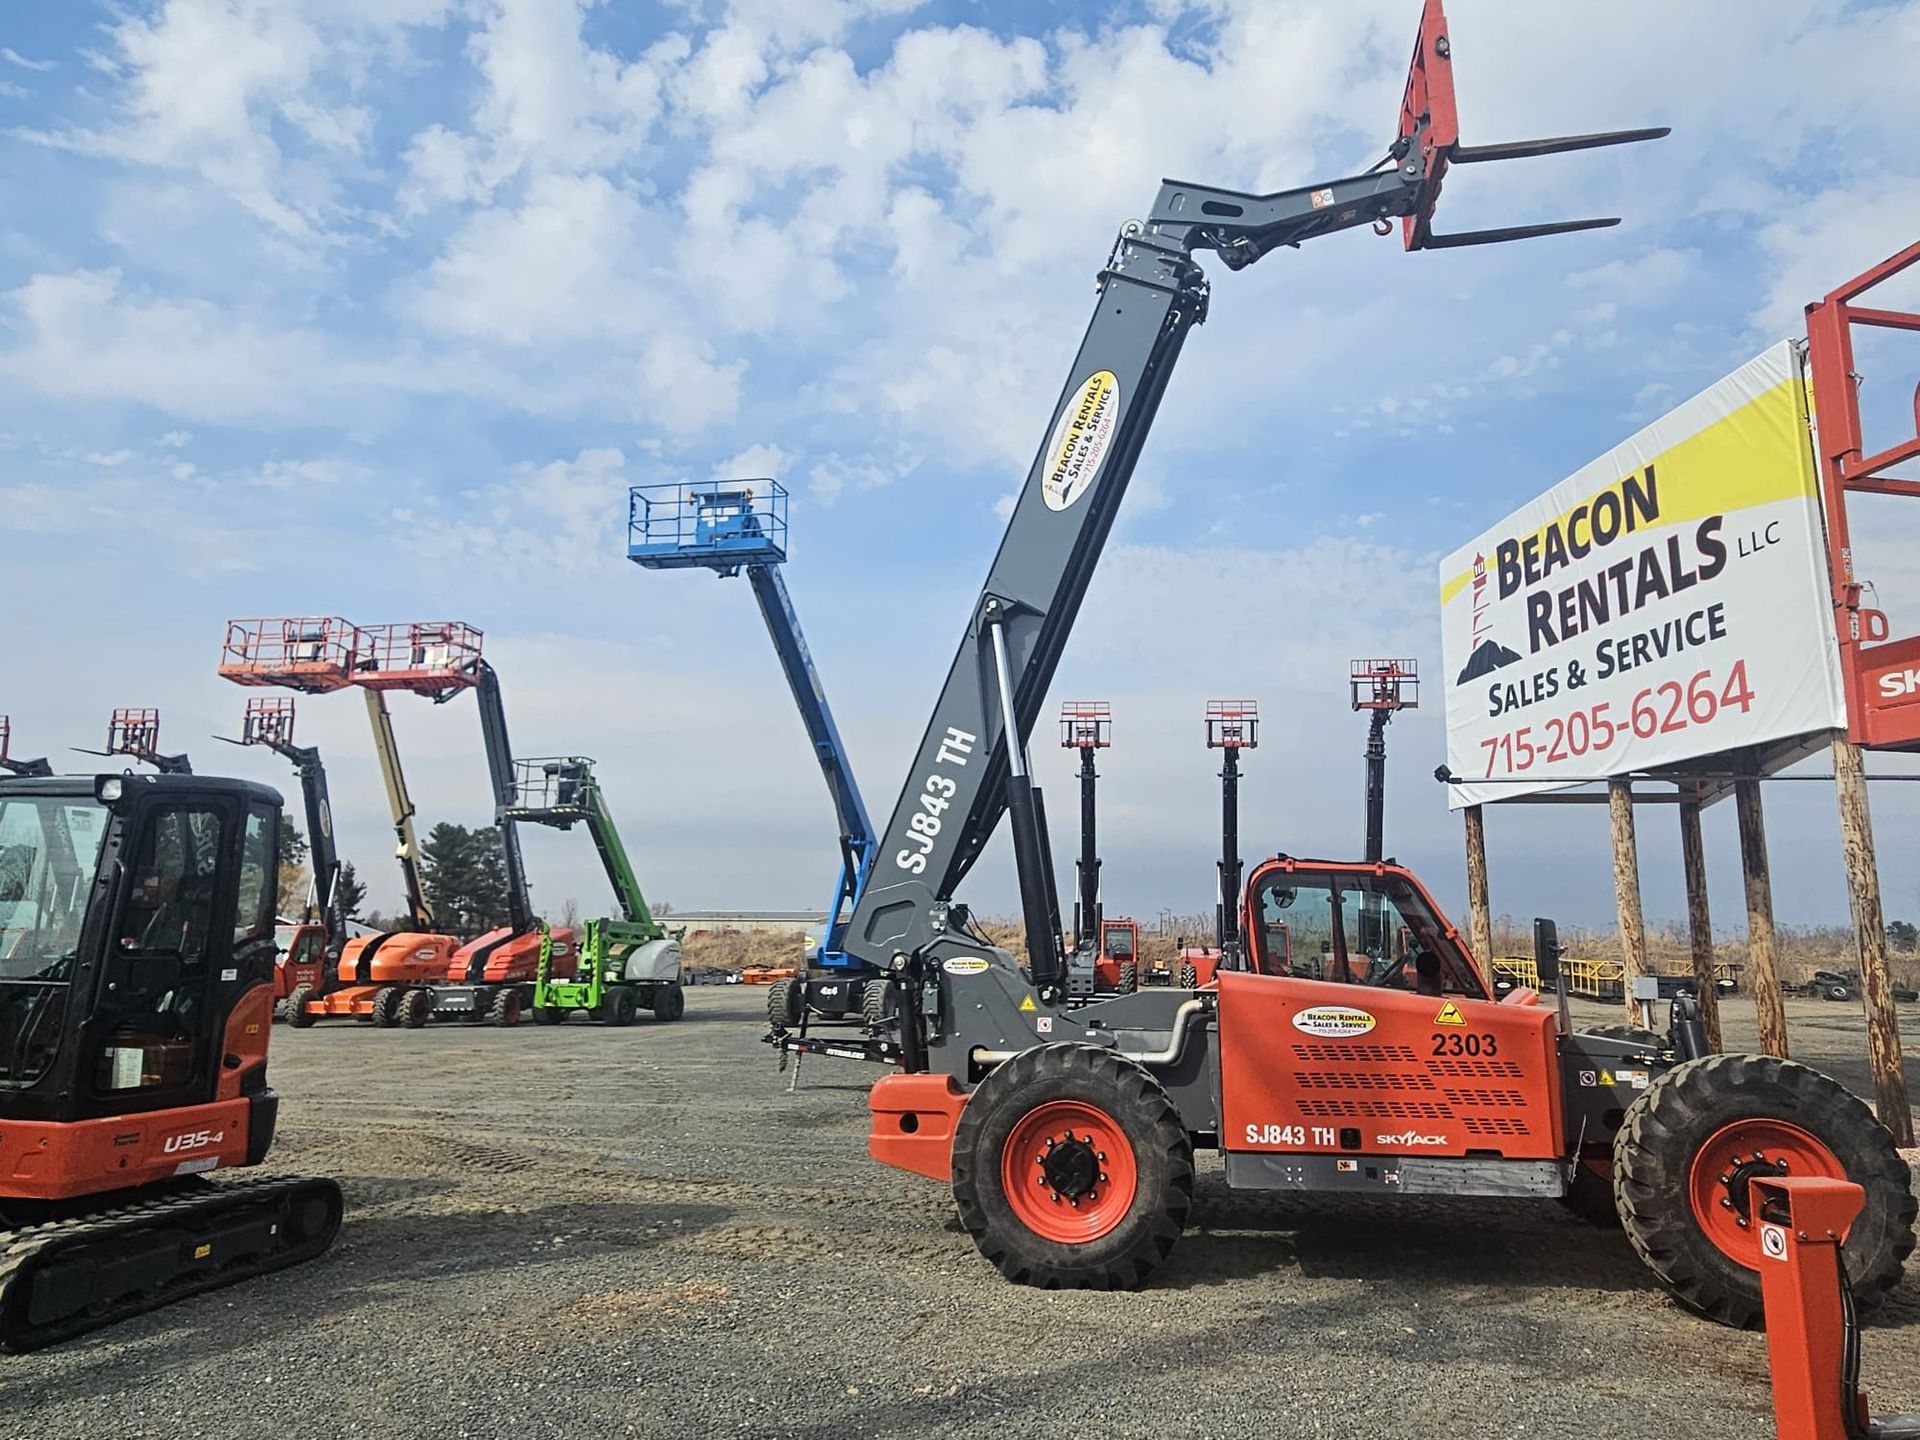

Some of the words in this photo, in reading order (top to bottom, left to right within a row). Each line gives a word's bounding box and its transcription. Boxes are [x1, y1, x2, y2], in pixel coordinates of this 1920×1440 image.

[1087, 387, 1112, 432] SERVICE
[1052, 433, 1080, 483] BEACON
[1073, 377, 1102, 431] RENTALS
[1084, 435, 1093, 444] &
[1085, 418, 1112, 473] 715-205-6264
[1068, 445, 1089, 479] SALES
[1496, 464, 1660, 601] BEACON
[1527, 515, 1727, 655] RENTALS
[1737, 520, 1781, 559] LLC
[1488, 667, 1559, 718] SALES
[1566, 660, 1588, 688] &
[1597, 602, 1727, 679] SERVICE
[1480, 659, 1756, 779] 715-205-6264
[896, 774, 957, 875] SJ843
[935, 726, 977, 766] TH
[1307, 1013, 1337, 1021] BEACON
[1338, 1013, 1371, 1022] RENTALS
[1340, 1021, 1367, 1029] SERVICE
[1431, 1033, 1498, 1058] 2303
[163, 1130, 224, 1153] U35-4
[1246, 1124, 1306, 1146] SJ843
[1311, 1127, 1335, 1147] TH
[1376, 1130, 1448, 1147] SKYJACK
